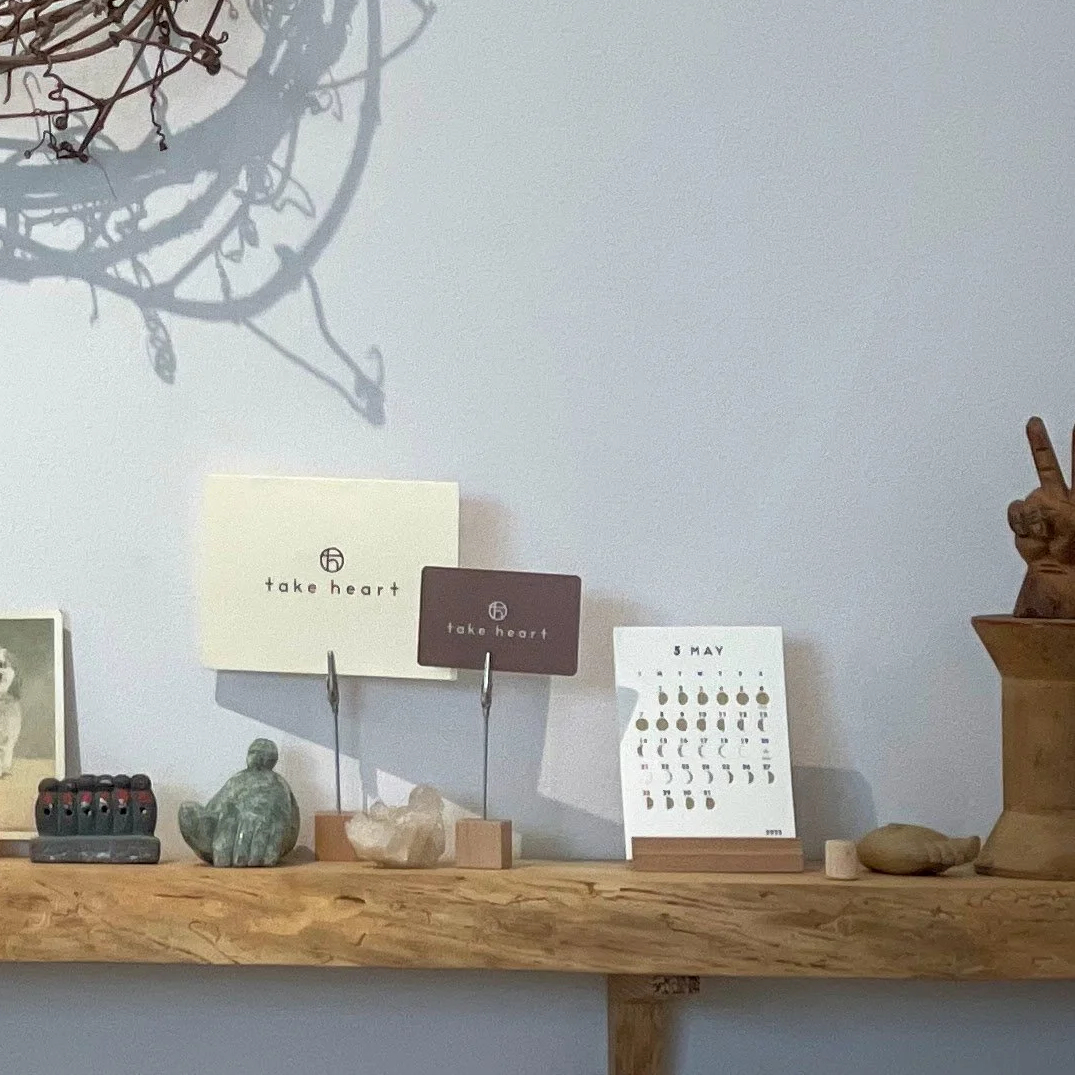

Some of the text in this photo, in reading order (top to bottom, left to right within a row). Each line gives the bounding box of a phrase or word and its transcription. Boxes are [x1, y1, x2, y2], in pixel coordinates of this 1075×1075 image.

[265, 577, 399, 596] take heart
[447, 622, 547, 640] take heart
[674, 646, 723, 656] 5 MAY
